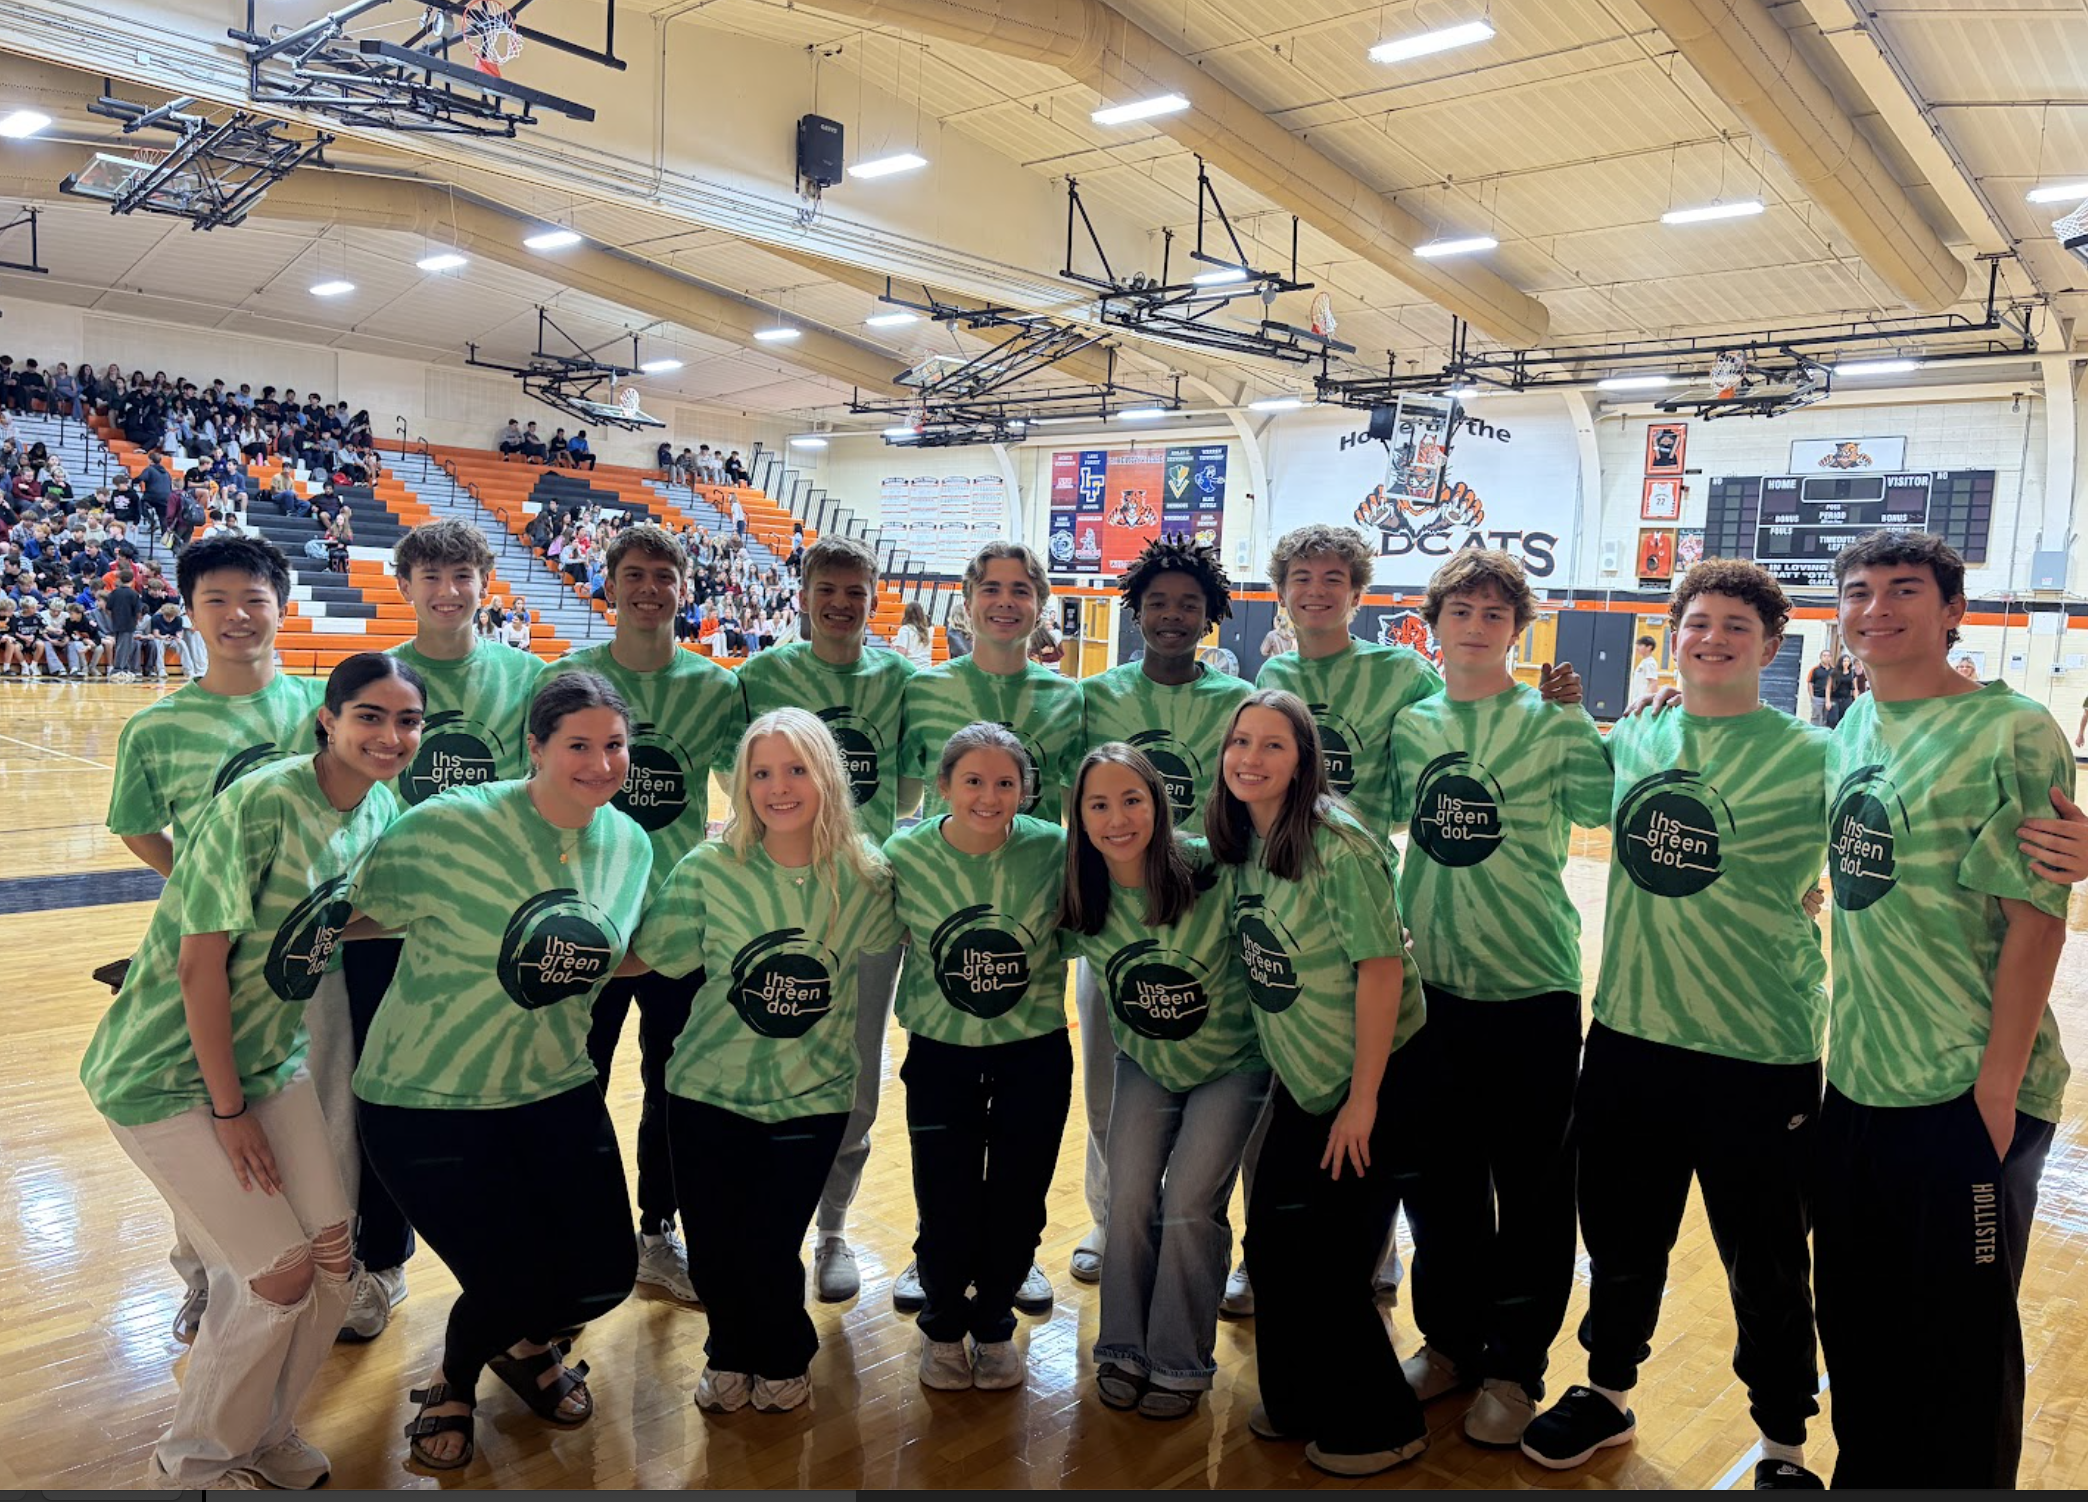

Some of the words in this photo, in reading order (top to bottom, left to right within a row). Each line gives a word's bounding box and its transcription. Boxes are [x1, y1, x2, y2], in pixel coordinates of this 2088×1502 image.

[1339, 421, 1412, 451] Hoe
[1465, 418, 1511, 443] the
[1080, 467, 1105, 502] LF
[1767, 479, 1797, 490] HOME
[1887, 476, 1929, 487] VISITOR
[1775, 515, 1800, 523] BONUS
[1819, 511, 1847, 520] PERIOD
[1881, 514, 1908, 522] BONUS
[1770, 527, 1793, 535] FOULS
[1374, 530, 1559, 577] DCATS
[1828, 543, 1846, 551] LEFT
[840, 759, 870, 773] een
[432, 767, 488, 783] green
[622, 777, 675, 793] green
[628, 790, 659, 806] dot
[1436, 810, 1488, 825] green
[1441, 823, 1473, 840] dot
[1646, 829, 1708, 855] green
[1838, 835, 1884, 861] green
[1651, 846, 1685, 868] dot
[1840, 853, 1864, 877] dot
[539, 954, 600, 971] green
[963, 961, 1018, 980] green
[1243, 949, 1284, 975] green
[540, 966, 574, 984] dot
[1250, 967, 1271, 987] dot
[763, 986, 820, 1000] green
[970, 976, 1003, 993] dot
[766, 997, 801, 1016] dot
[1139, 991, 1195, 1009] green
[1149, 1005, 1182, 1020] dot
[1971, 1183, 1997, 1265] HOLLISTER
